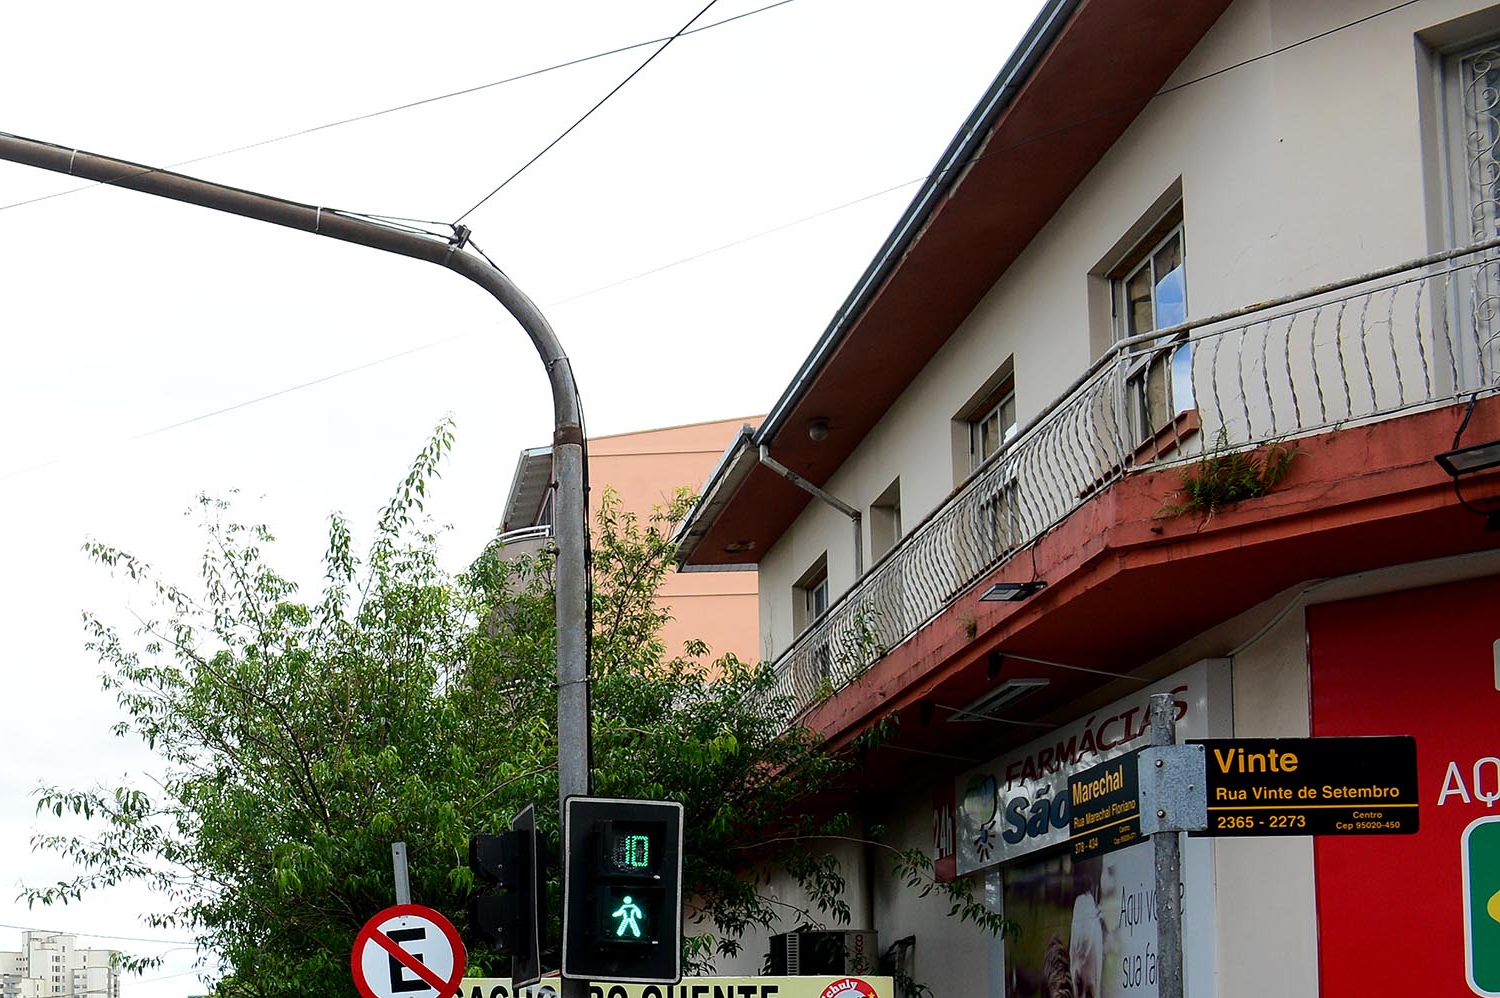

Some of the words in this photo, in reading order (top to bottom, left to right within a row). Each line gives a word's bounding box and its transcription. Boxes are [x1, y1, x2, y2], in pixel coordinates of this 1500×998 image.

[1214, 748, 1298, 773] Vinte
[1072, 764, 1124, 807] Marechal
[1216, 787, 1247, 800] Rua
[1252, 787, 1293, 799] Vinte
[1297, 785, 1317, 798] de
[1322, 785, 1400, 798] Setembro
[1002, 784, 1070, 845] São
[1073, 812, 1086, 830] Rua
[1085, 802, 1111, 826] Marechal
[1111, 799, 1137, 816] Floriano
[1217, 816, 1254, 829] 2365
[1269, 815, 1306, 828] 2273
[1335, 821, 1354, 830] Cep
[1355, 820, 1400, 829] 95020-450
[1352, 811, 1383, 819] Centro
[625, 835, 648, 867] 10
[1118, 882, 1144, 936] Aqui
[1122, 954, 1142, 988] sua
